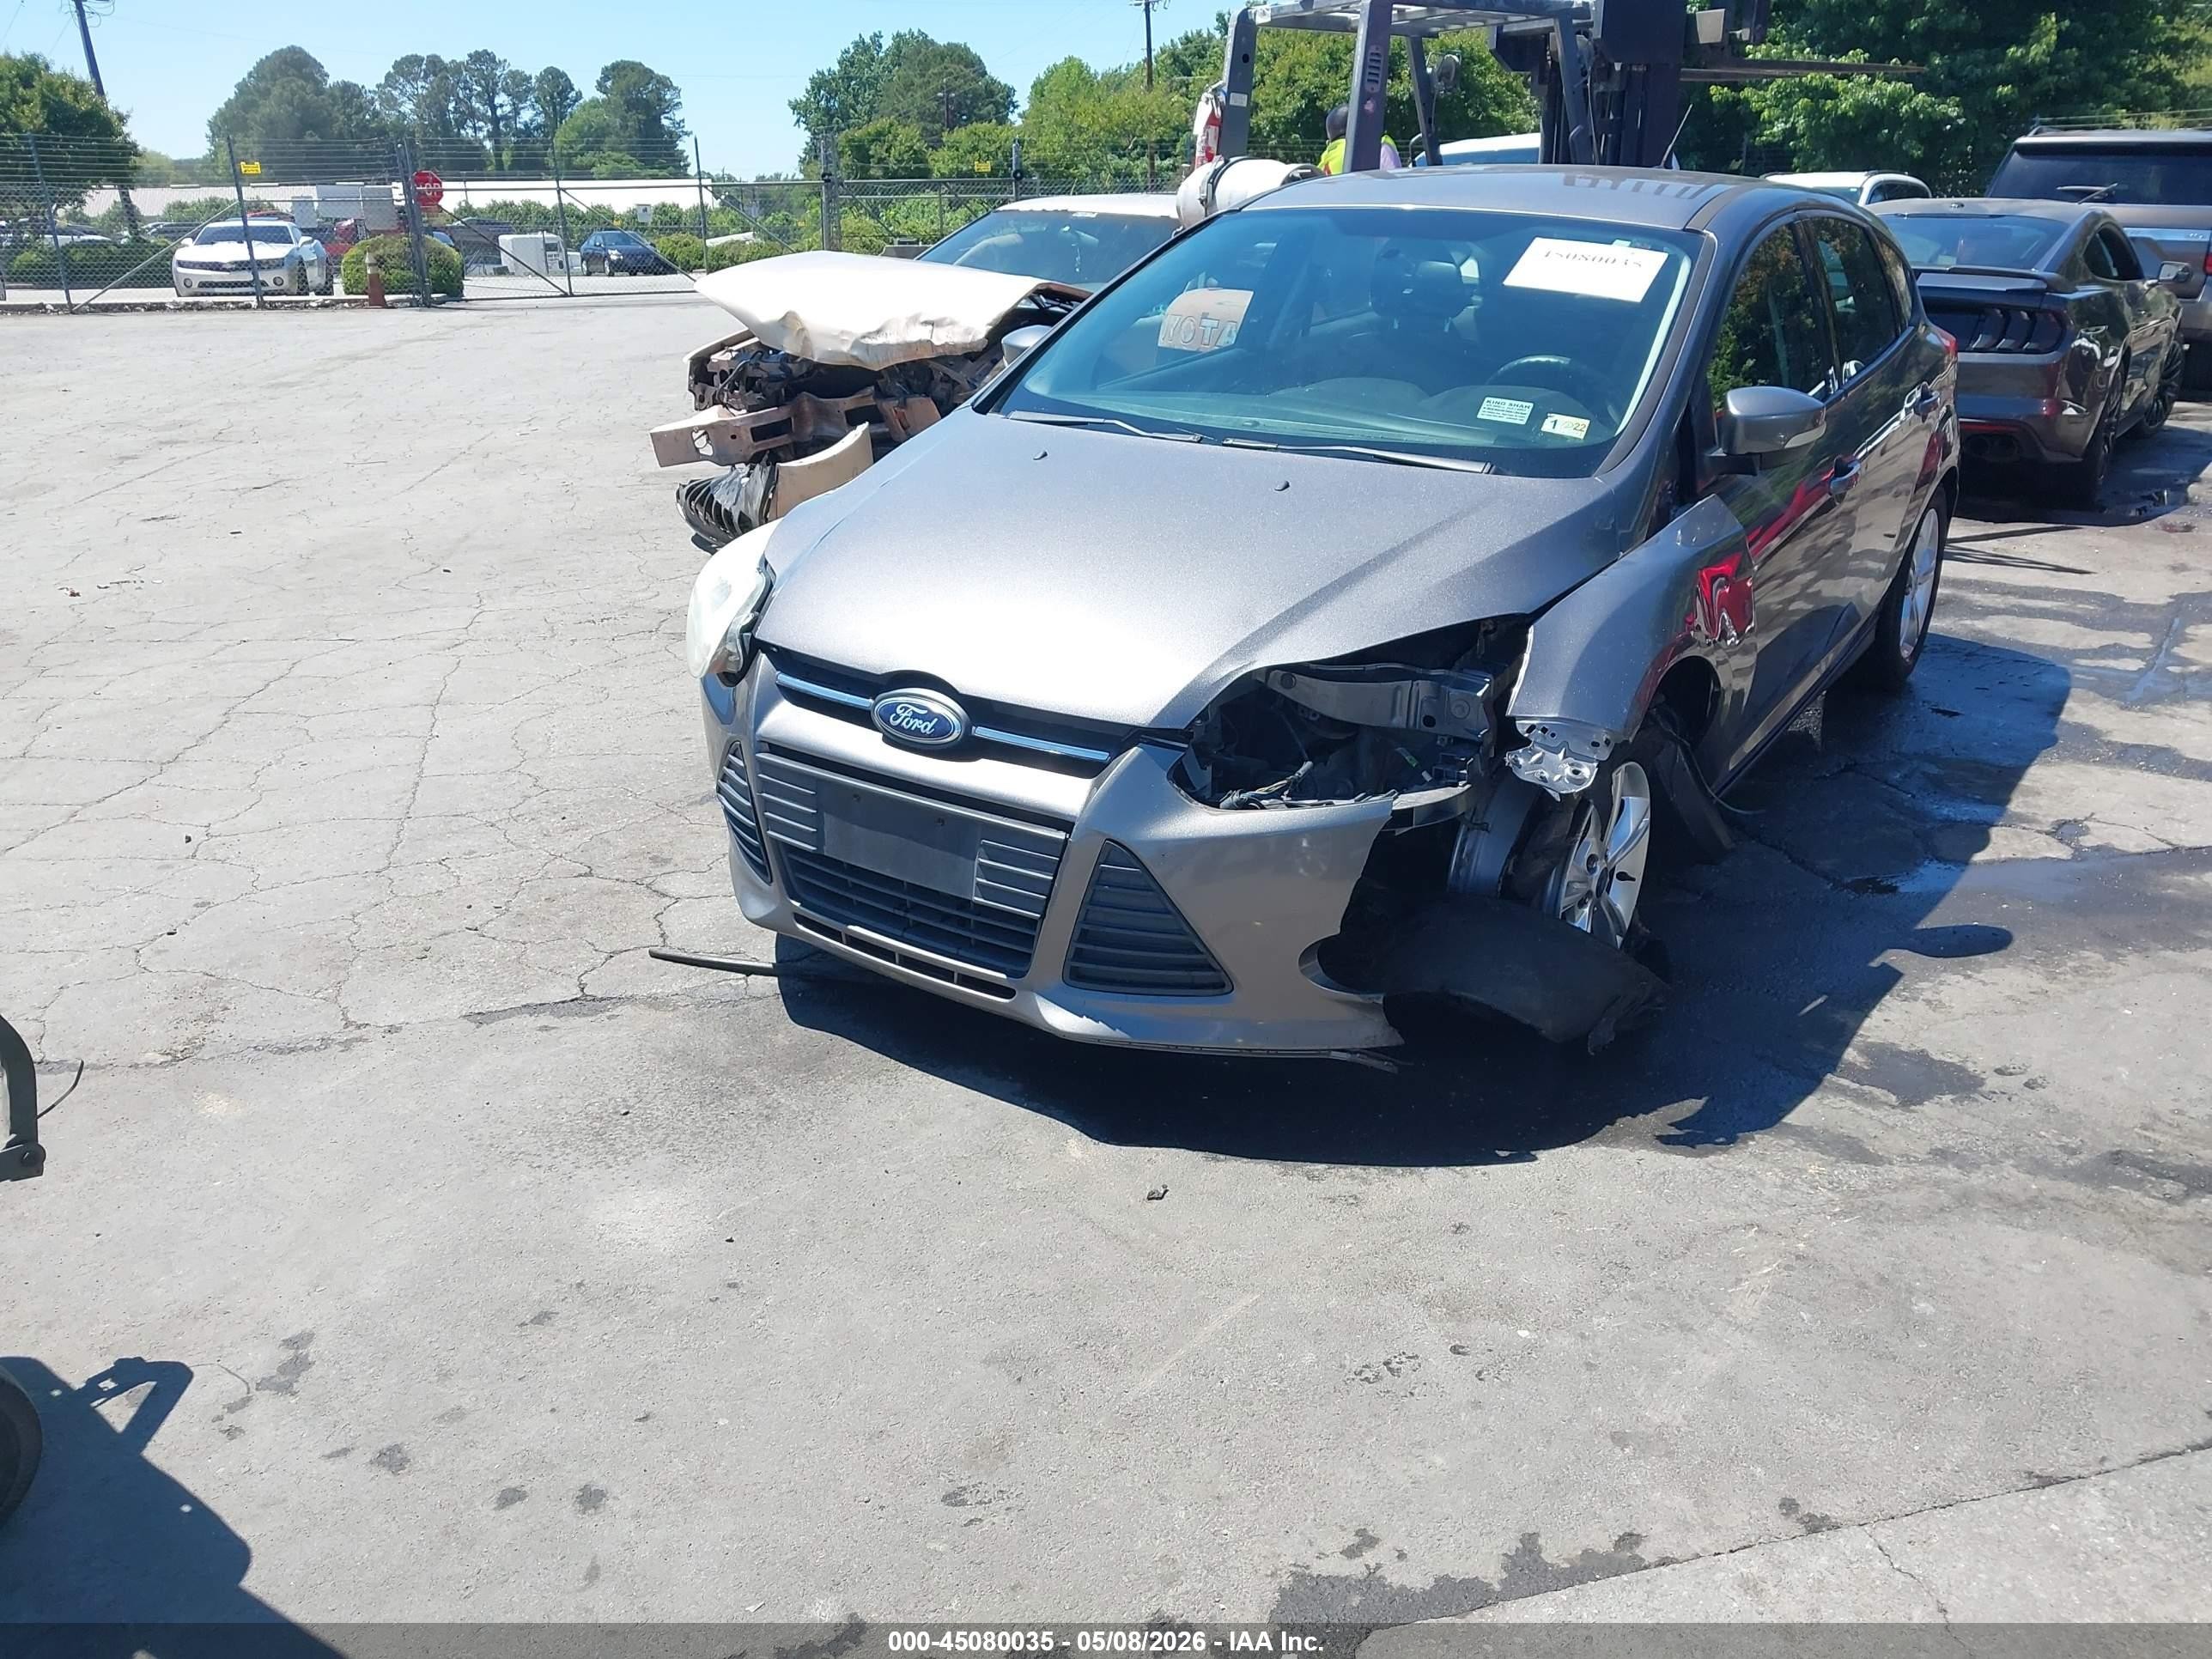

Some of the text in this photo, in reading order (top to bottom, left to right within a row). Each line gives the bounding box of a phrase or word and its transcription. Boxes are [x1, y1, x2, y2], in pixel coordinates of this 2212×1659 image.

[1550, 418, 1587, 433] 1 22
[890, 703, 938, 734] Ford
